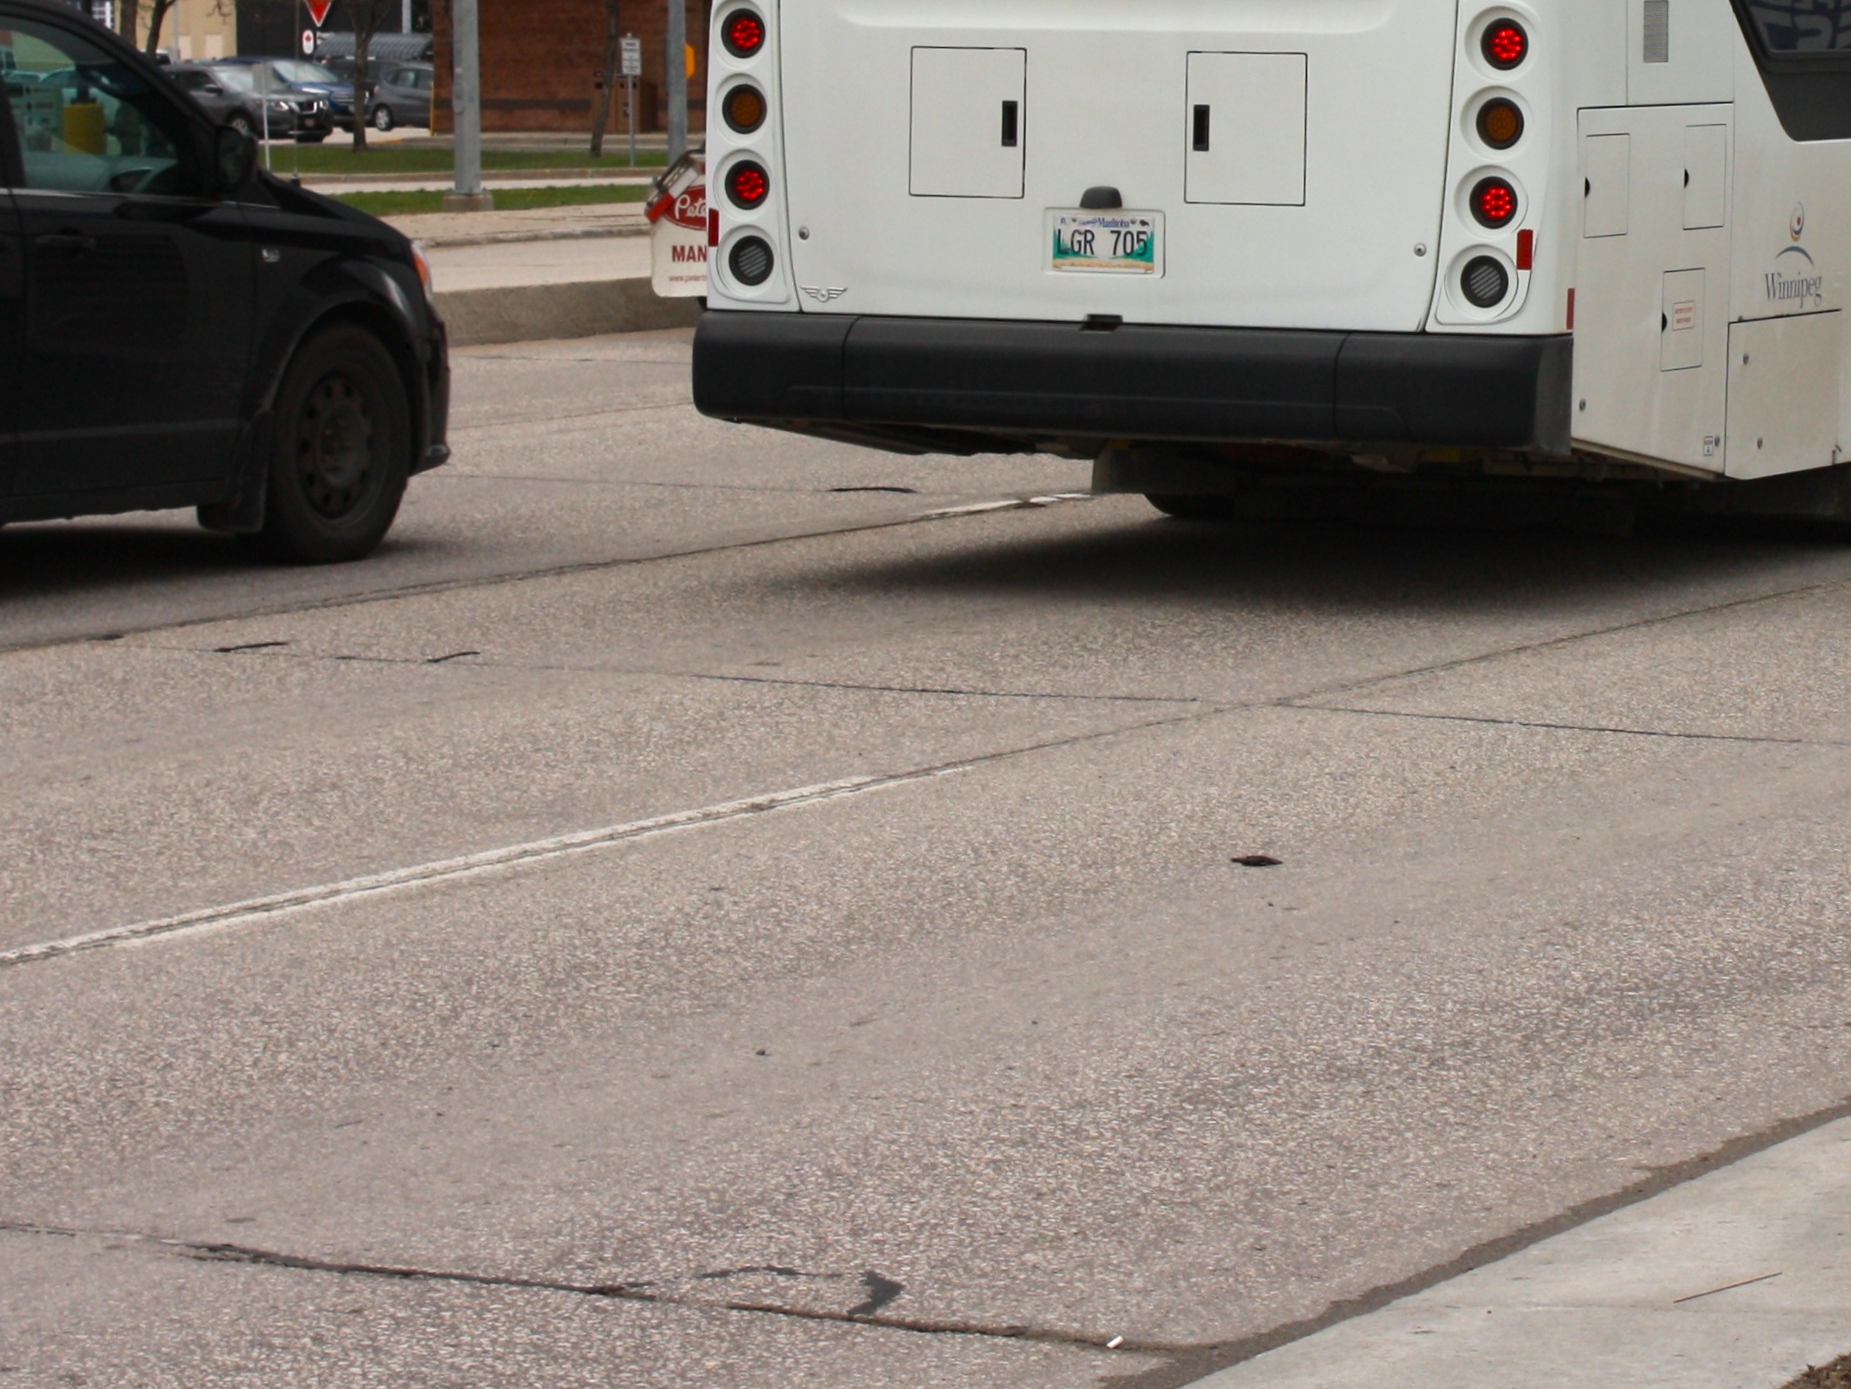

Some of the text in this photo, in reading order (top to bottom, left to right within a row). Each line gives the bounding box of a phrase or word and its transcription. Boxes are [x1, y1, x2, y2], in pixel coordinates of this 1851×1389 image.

[1057, 228, 1148, 257] LGR 705
[1765, 271, 1823, 309] Winnipeg
